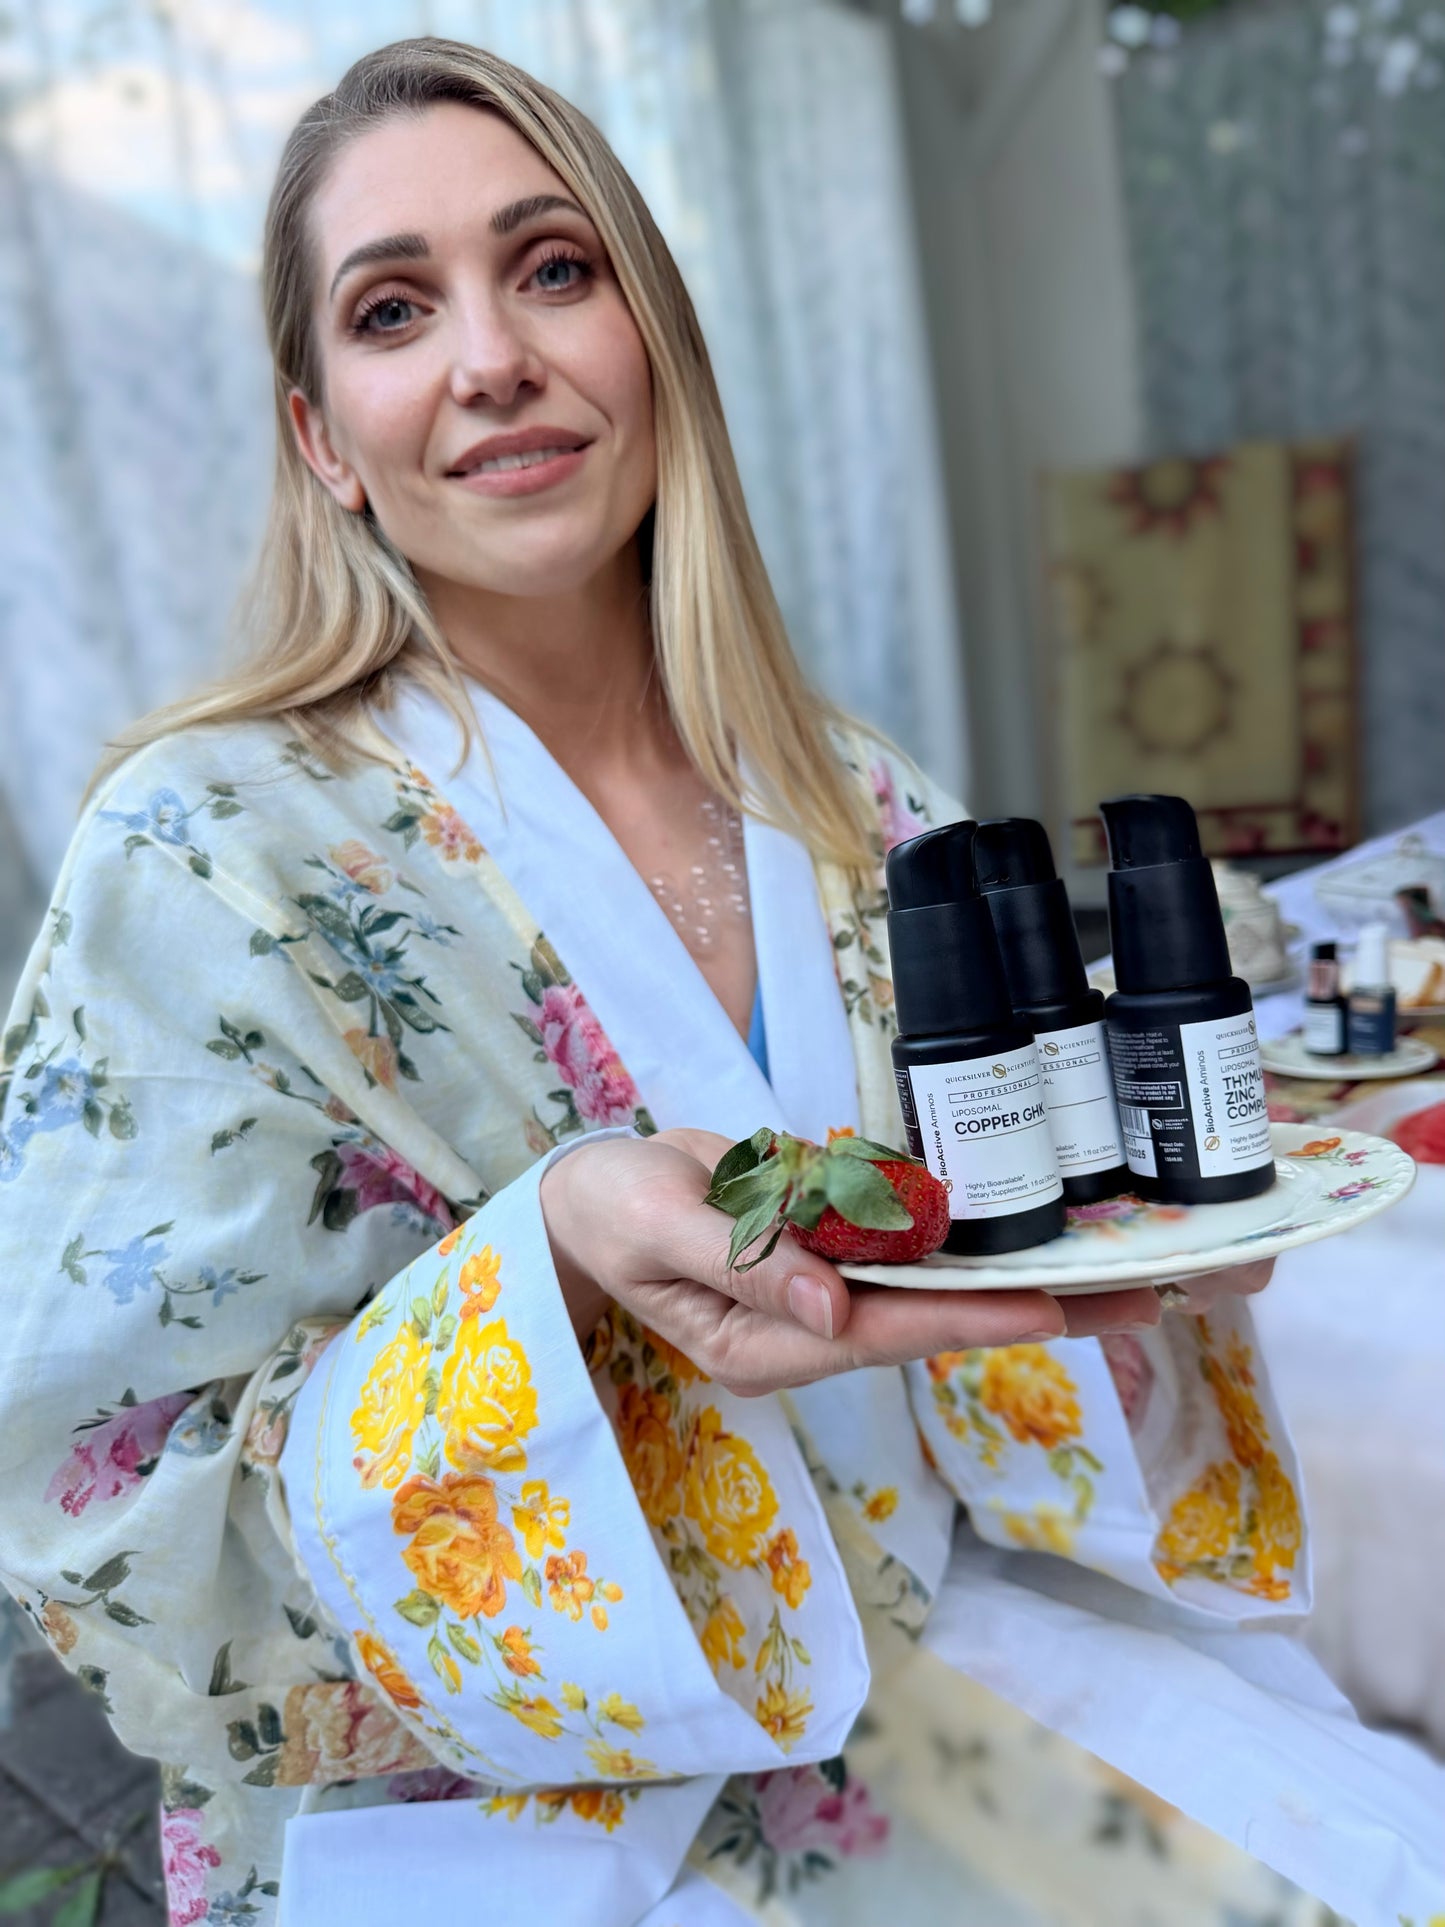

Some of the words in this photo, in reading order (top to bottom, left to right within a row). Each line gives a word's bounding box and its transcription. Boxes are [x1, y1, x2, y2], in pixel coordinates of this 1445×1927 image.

[1060, 1037, 1096, 1050] SCIENTIFIC
[945, 1071, 991, 1084] QUICKSILVER
[1006, 1058, 1036, 1073] SCIENTIFIC
[1043, 1057, 1089, 1071] ESSIONAL
[1197, 1050, 1209, 1085] Aminos
[1220, 1059, 1255, 1074] LIPOSOMAL
[963, 1080, 1032, 1100] PROFESSIONAL
[1224, 1086, 1256, 1105] ZINC
[927, 1093, 939, 1129] Aminos
[951, 1103, 1002, 1118] LIPOSOMAL
[954, 1111, 1020, 1135] COPPER
[1022, 1102, 1046, 1122] GHK
[1202, 1087, 1215, 1133] BioActive
[1230, 1135, 1247, 1144] Highly
[934, 1130, 948, 1176] BioActive
[1231, 1144, 1251, 1153] Dietary
[965, 1182, 986, 1191] Highly
[967, 1190, 990, 1199] Dietary
[991, 1184, 1029, 1197] Supplement
